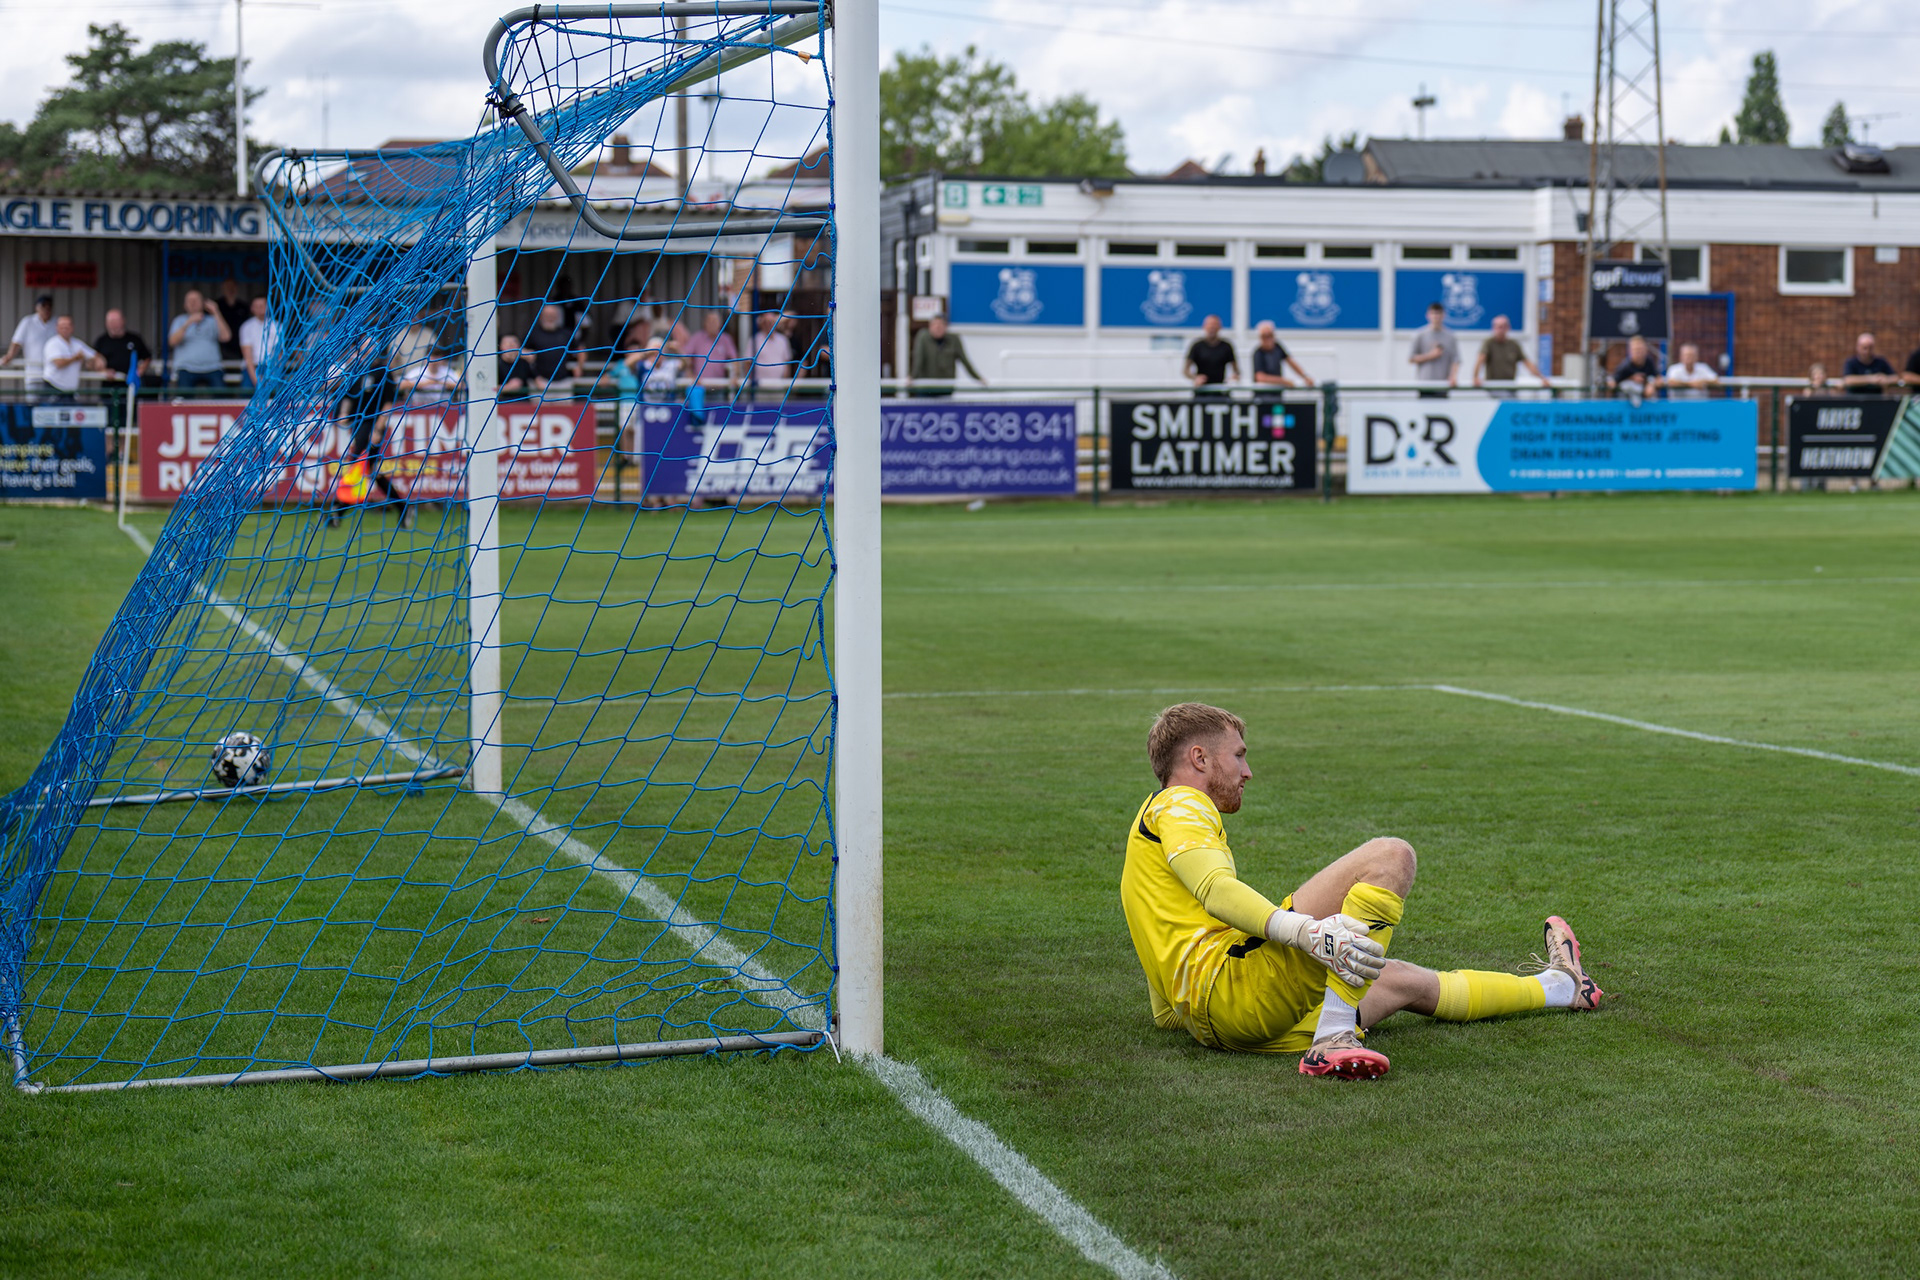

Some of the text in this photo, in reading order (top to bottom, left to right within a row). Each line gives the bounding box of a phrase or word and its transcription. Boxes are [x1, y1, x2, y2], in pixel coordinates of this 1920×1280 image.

[84, 203, 260, 235] FLOORING
[964, 411, 1022, 443] 538
[1024, 411, 1074, 443] 341
[1131, 404, 1259, 439] SMITH
[1510, 412, 1678, 426] CCTV DRAINAGE SURVEY
[1510, 429, 1721, 443] HIGH PRESSURE WATER JETTING
[0, 443, 54, 459] ampions
[1130, 441, 1296, 475] LATIMER
[1510, 447, 1611, 461] DRAIN REPAIRS
